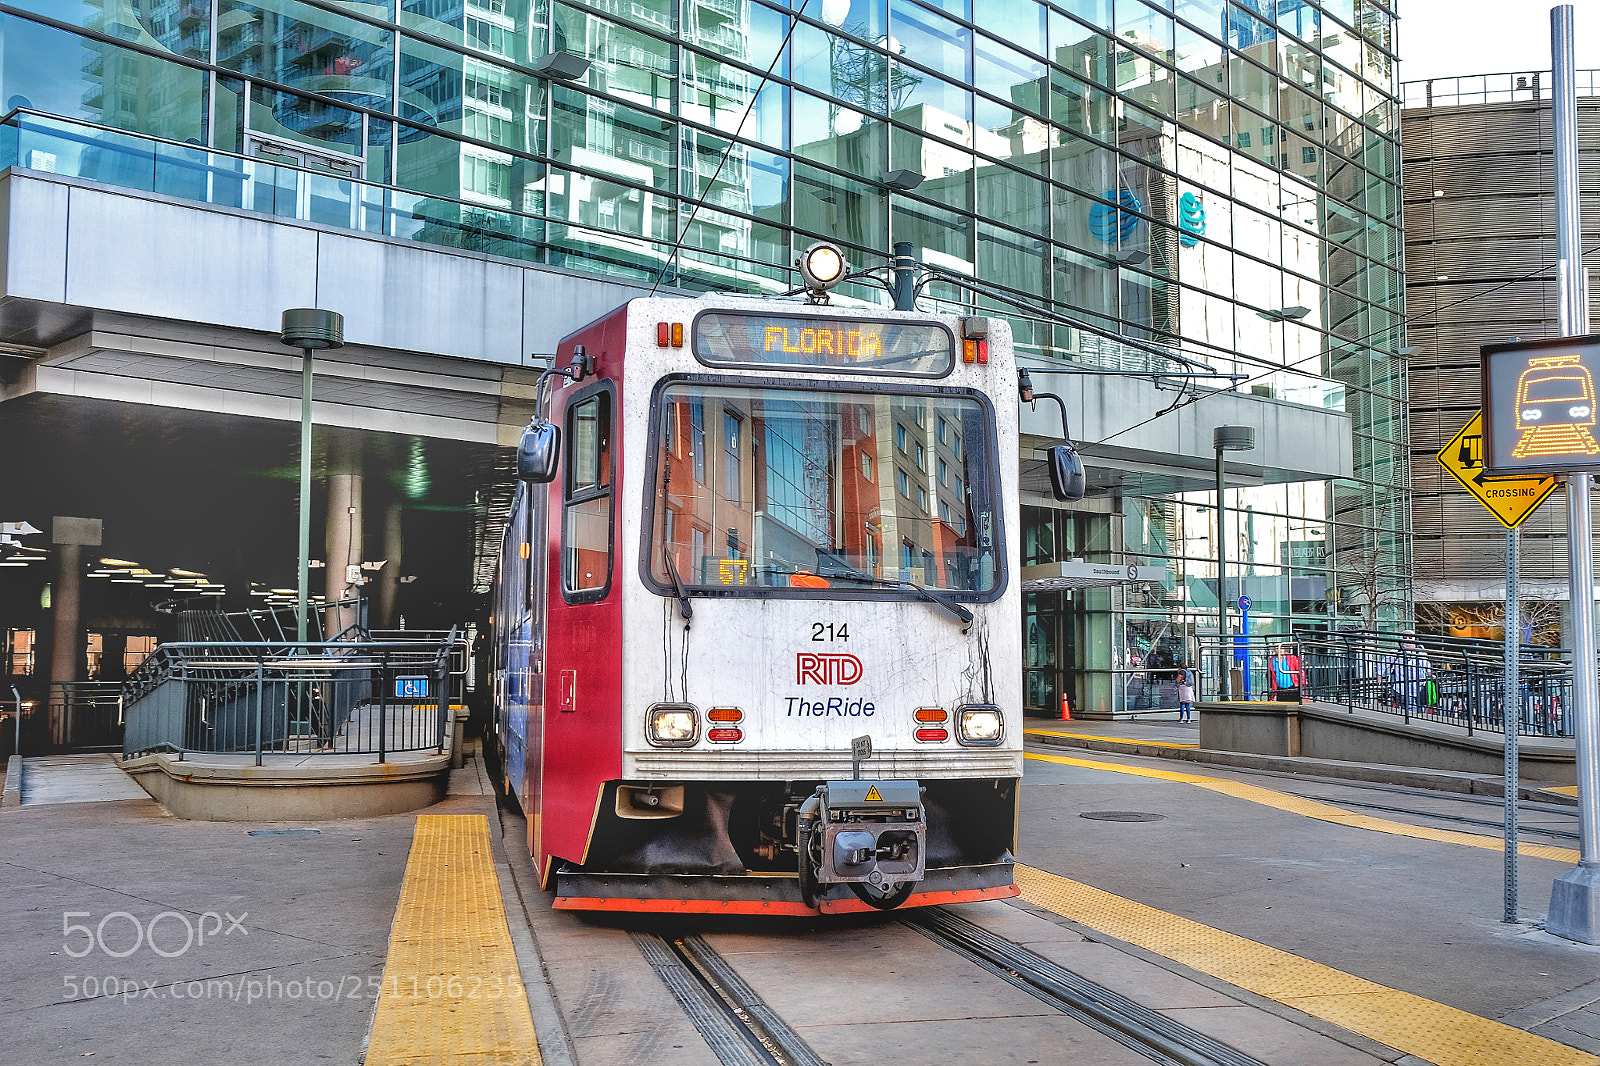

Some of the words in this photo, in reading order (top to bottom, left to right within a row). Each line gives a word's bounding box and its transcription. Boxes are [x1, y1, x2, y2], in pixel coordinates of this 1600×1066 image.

[765, 326, 882, 357] FLORIDA
[1486, 488, 1535, 498] CROSSING
[719, 559, 748, 585] 57
[811, 622, 850, 642] 214
[796, 652, 864, 686] RTD
[784, 697, 876, 717] TheRide
